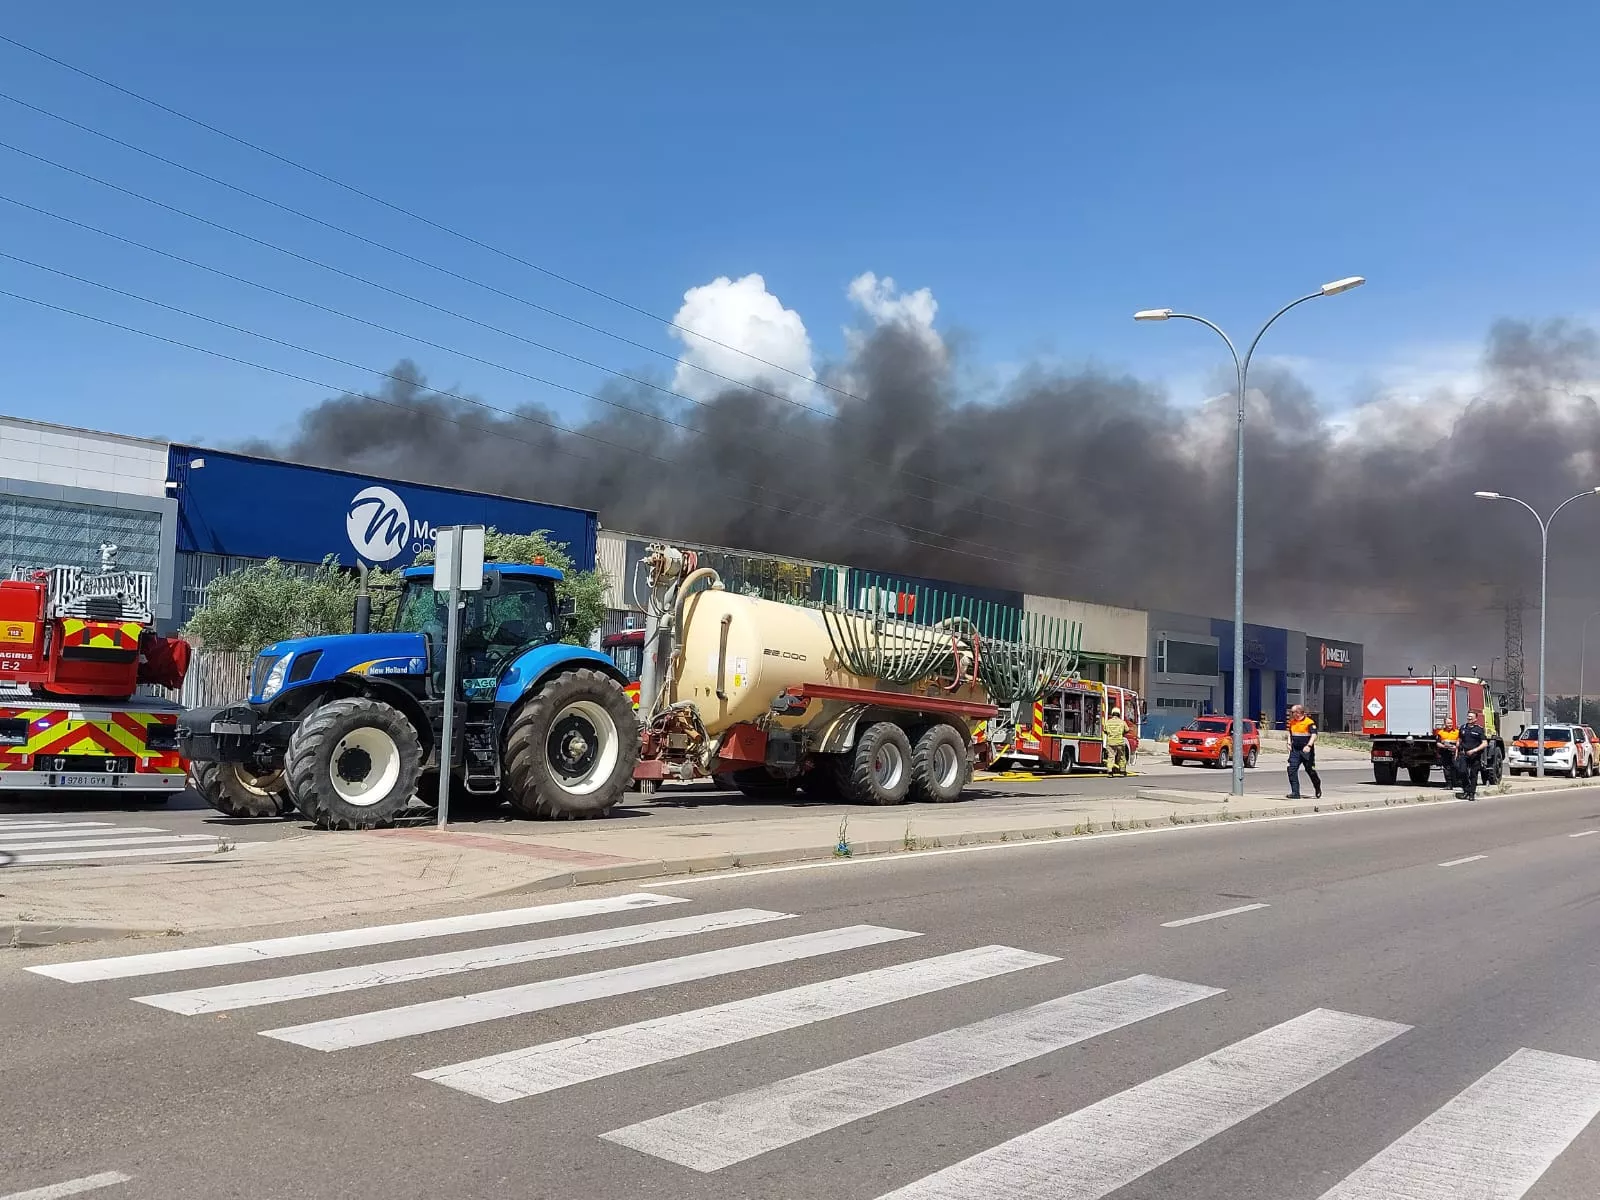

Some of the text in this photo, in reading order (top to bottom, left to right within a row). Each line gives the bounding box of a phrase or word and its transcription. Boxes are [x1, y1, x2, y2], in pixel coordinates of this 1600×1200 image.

[763, 648, 807, 661] 22.000
[1, 661, 20, 671] E-2
[369, 666, 384, 675] New
[385, 666, 408, 674] Holland
[67, 776, 88, 785] 9781
